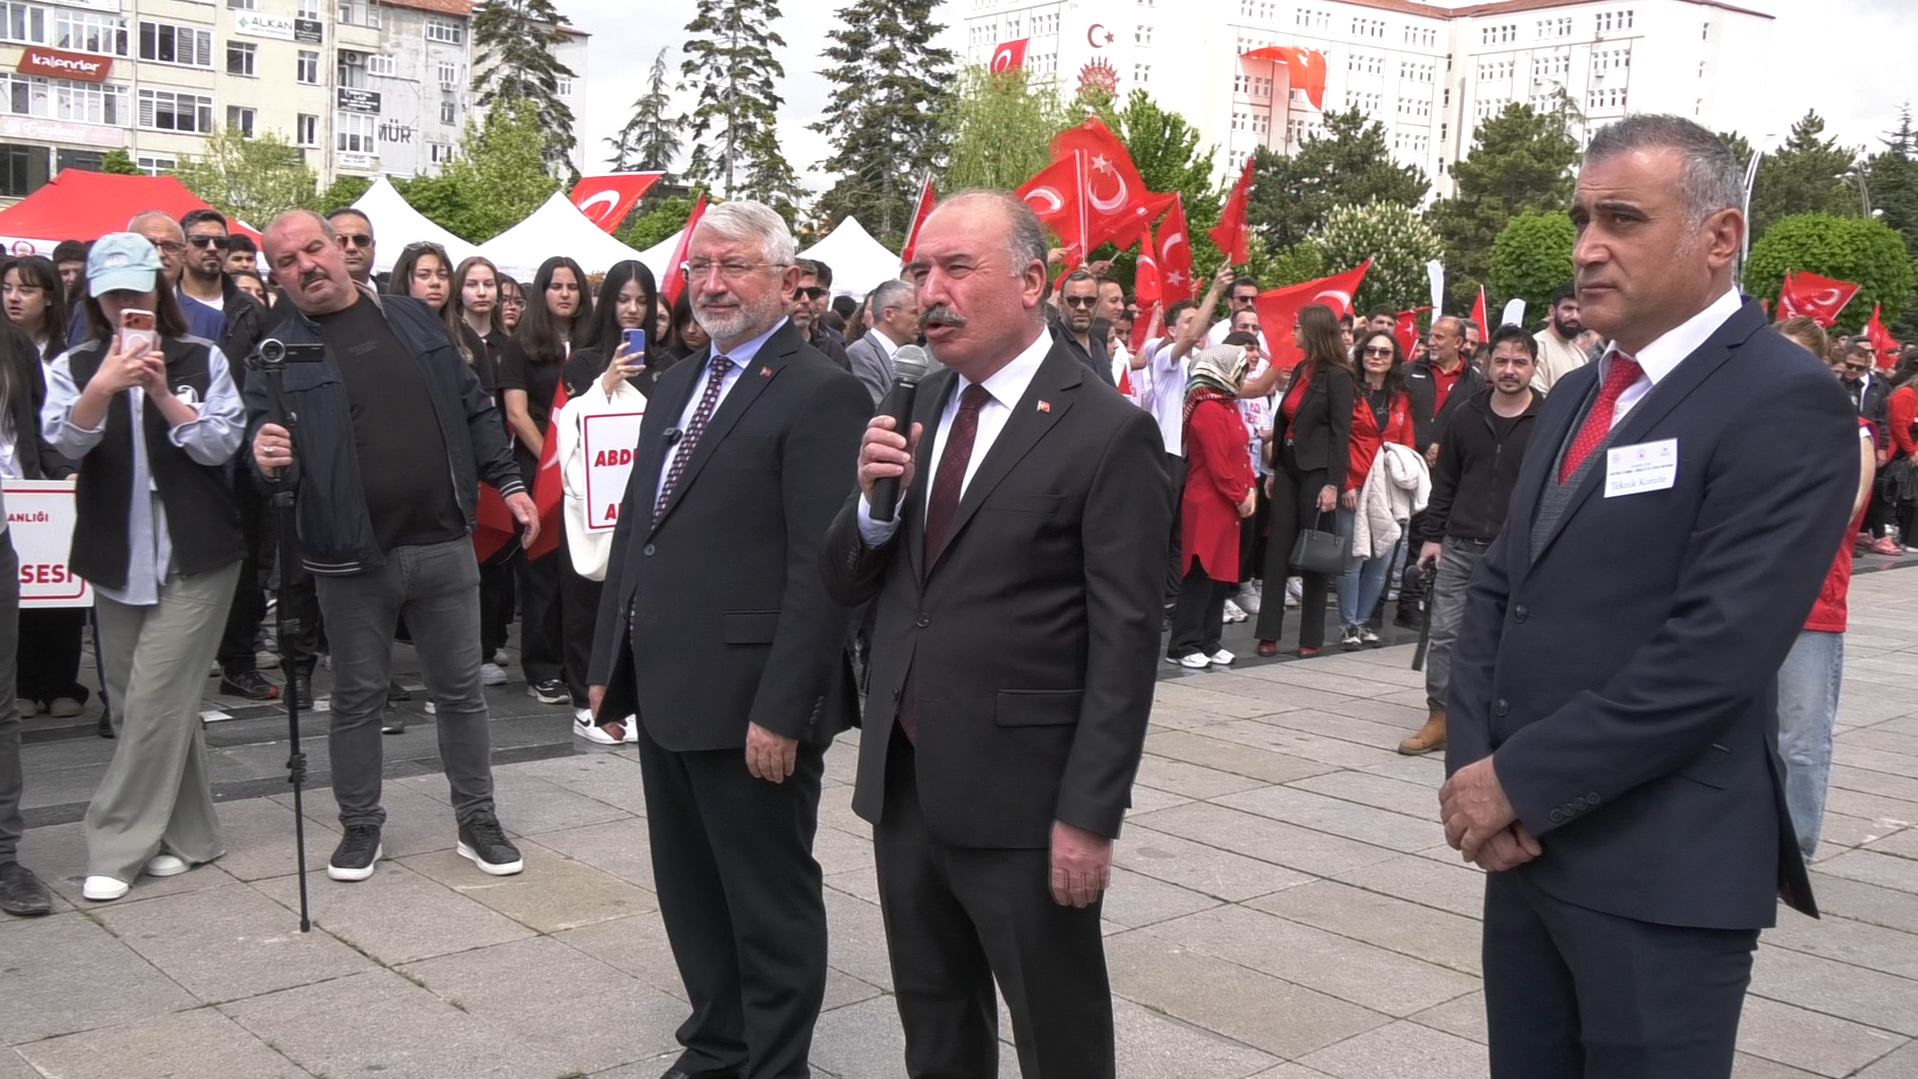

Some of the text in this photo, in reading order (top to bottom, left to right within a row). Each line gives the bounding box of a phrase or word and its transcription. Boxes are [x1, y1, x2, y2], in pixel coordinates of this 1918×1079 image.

[251, 16, 293, 31] ALKAN
[32, 53, 101, 72] kalender
[23, 121, 86, 138] Excellence
[1611, 479, 1636, 490] Teknik
[8, 511, 49, 522] ANLIĞI
[604, 503, 621, 521] A
